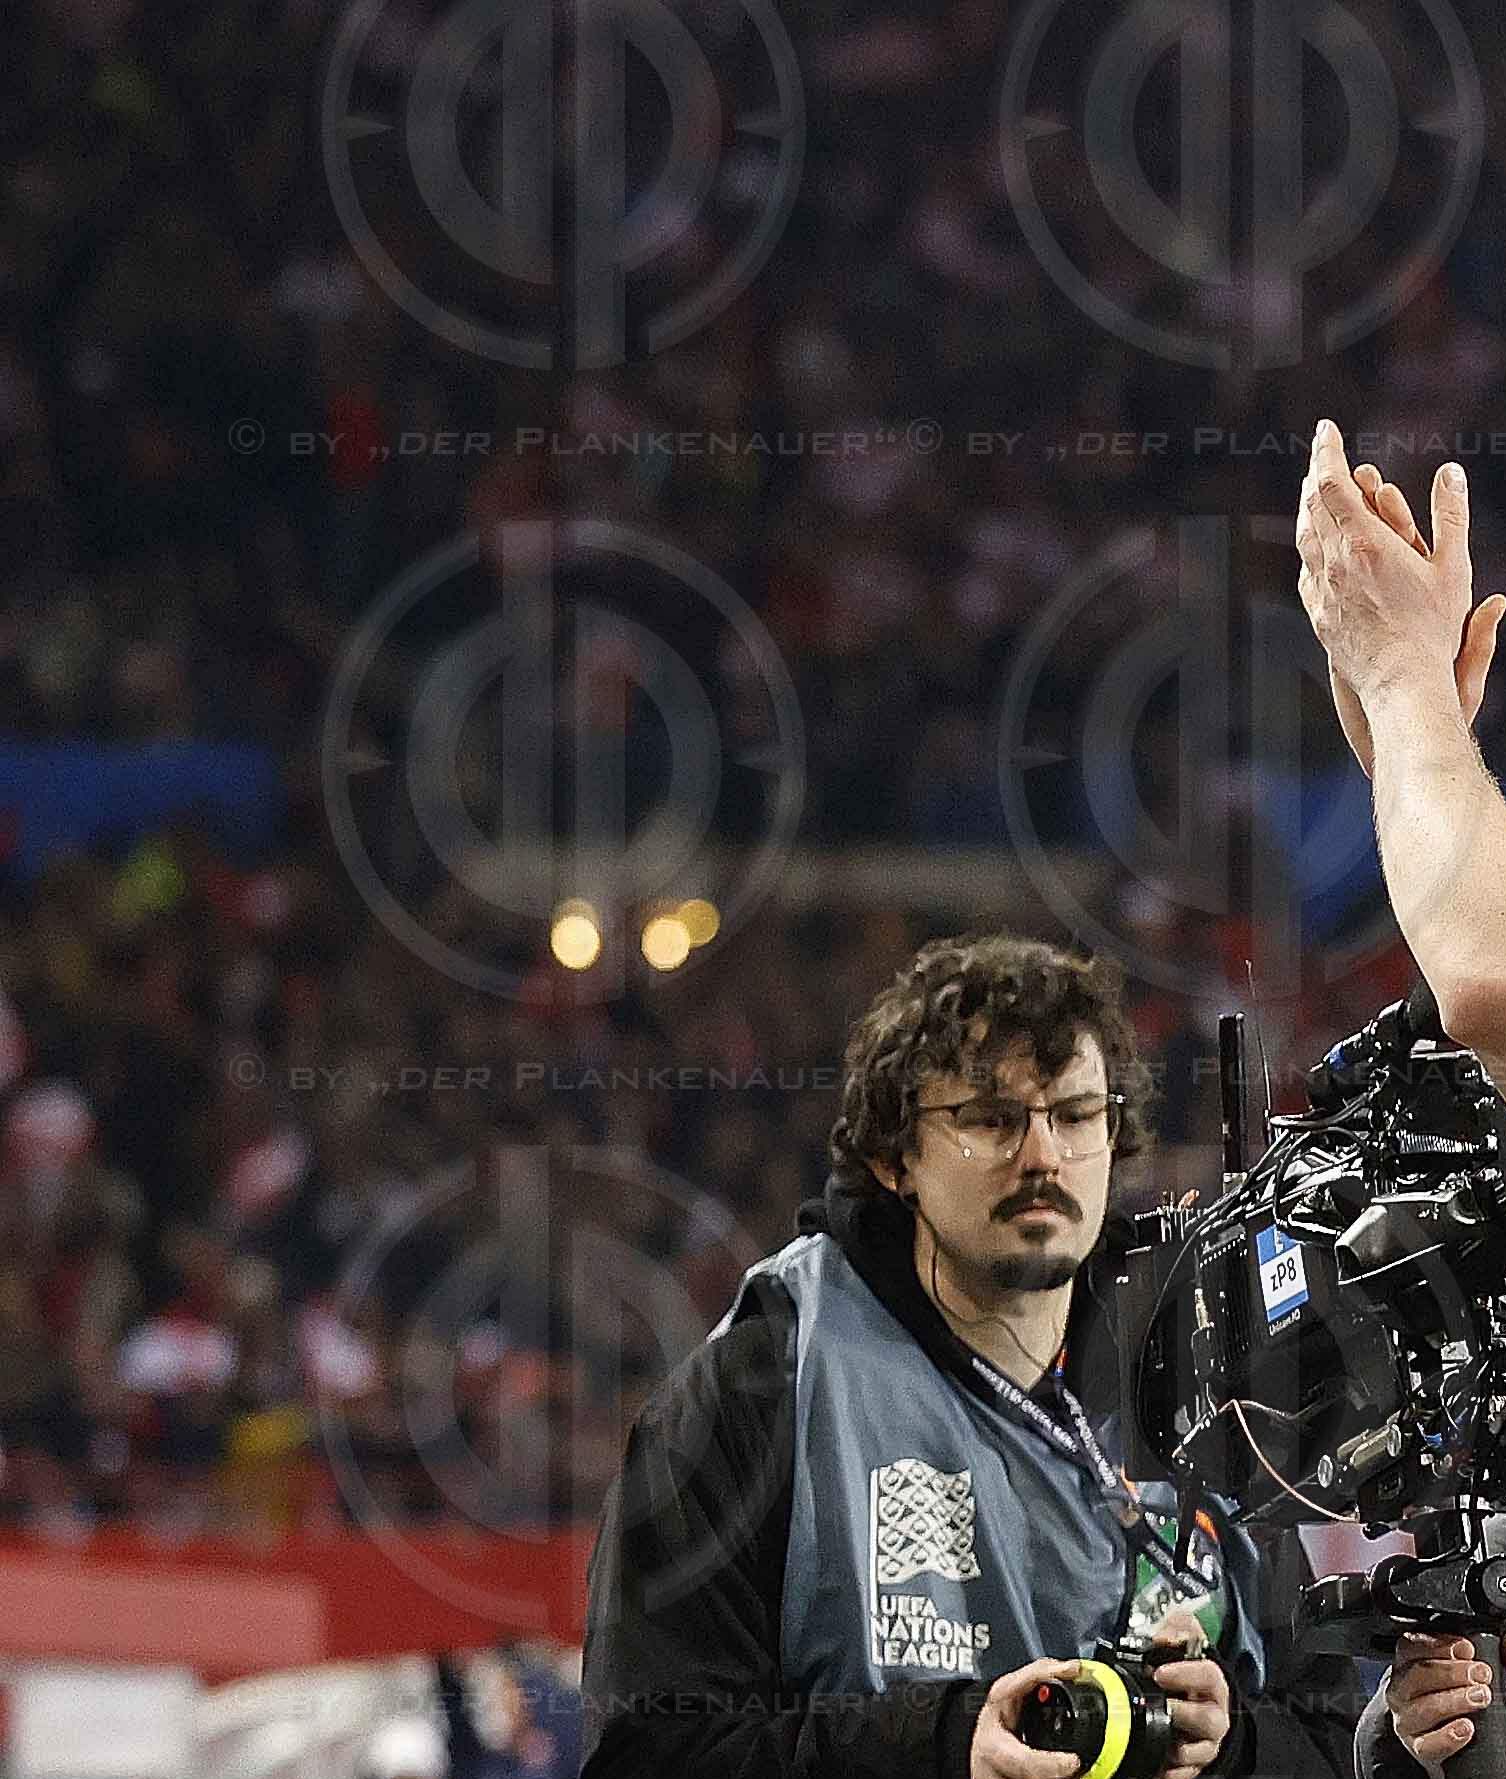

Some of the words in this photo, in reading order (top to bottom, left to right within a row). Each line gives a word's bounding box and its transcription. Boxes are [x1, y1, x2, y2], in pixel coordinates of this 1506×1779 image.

[880, 1594, 938, 1618] UEFA
[871, 1614, 991, 1650] NATIONS
[871, 1637, 975, 1674] LEAGUE
